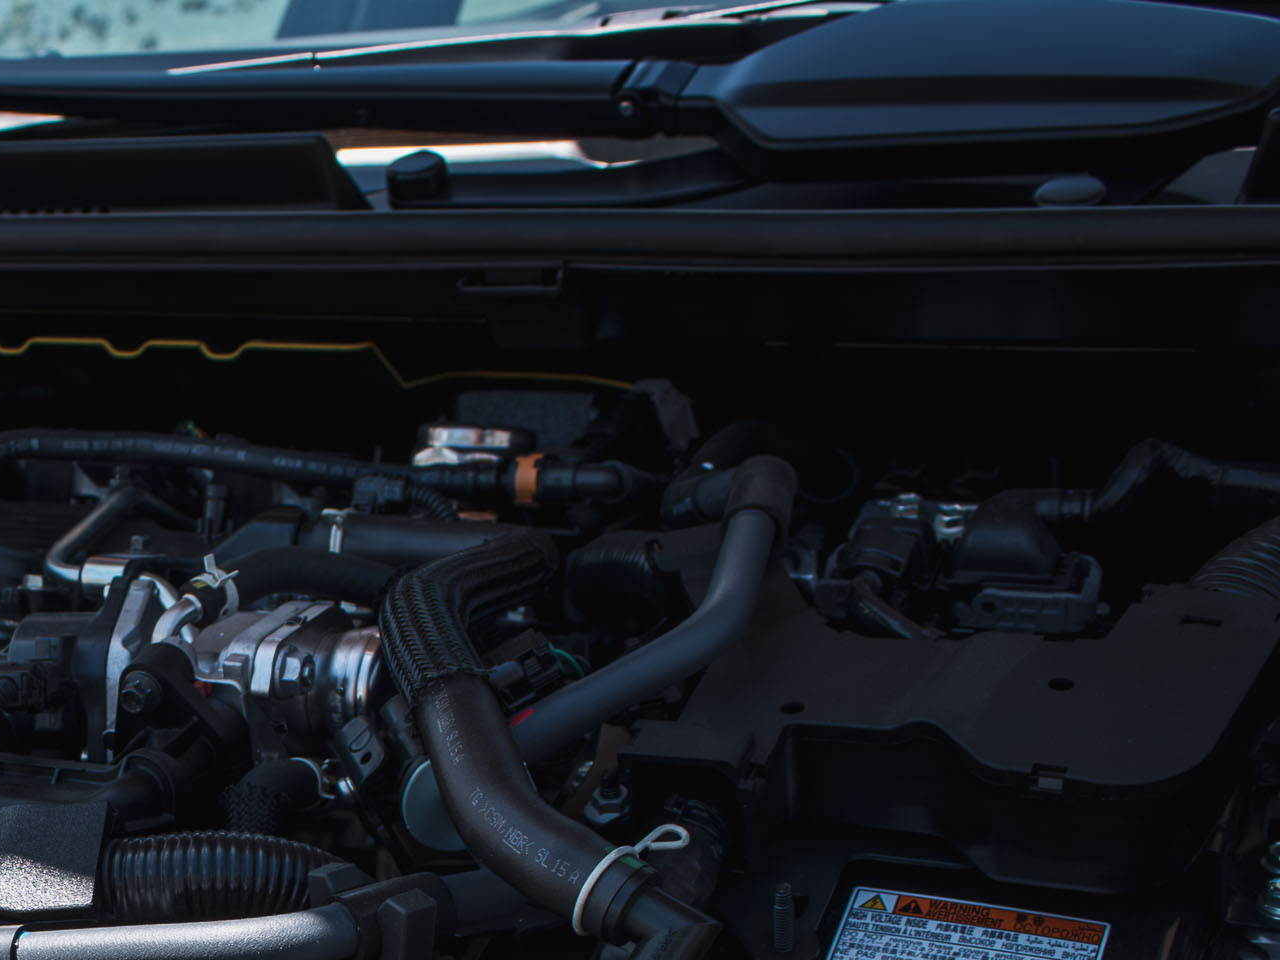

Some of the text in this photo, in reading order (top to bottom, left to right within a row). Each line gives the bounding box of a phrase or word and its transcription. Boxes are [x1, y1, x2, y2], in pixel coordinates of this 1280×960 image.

[927, 901, 990, 917] WARNING
[845, 920, 870, 929] HAUTE
[870, 923, 901, 934] TENSION
[849, 910, 929, 928] HIGH VOLTAGE INSIDE
[862, 933, 883, 941] NOT
[888, 938, 923, 946] remove
[927, 943, 953, 951] these
[957, 948, 988, 956] covers
[834, 947, 850, 955] NE
[854, 950, 876, 959] PAS
